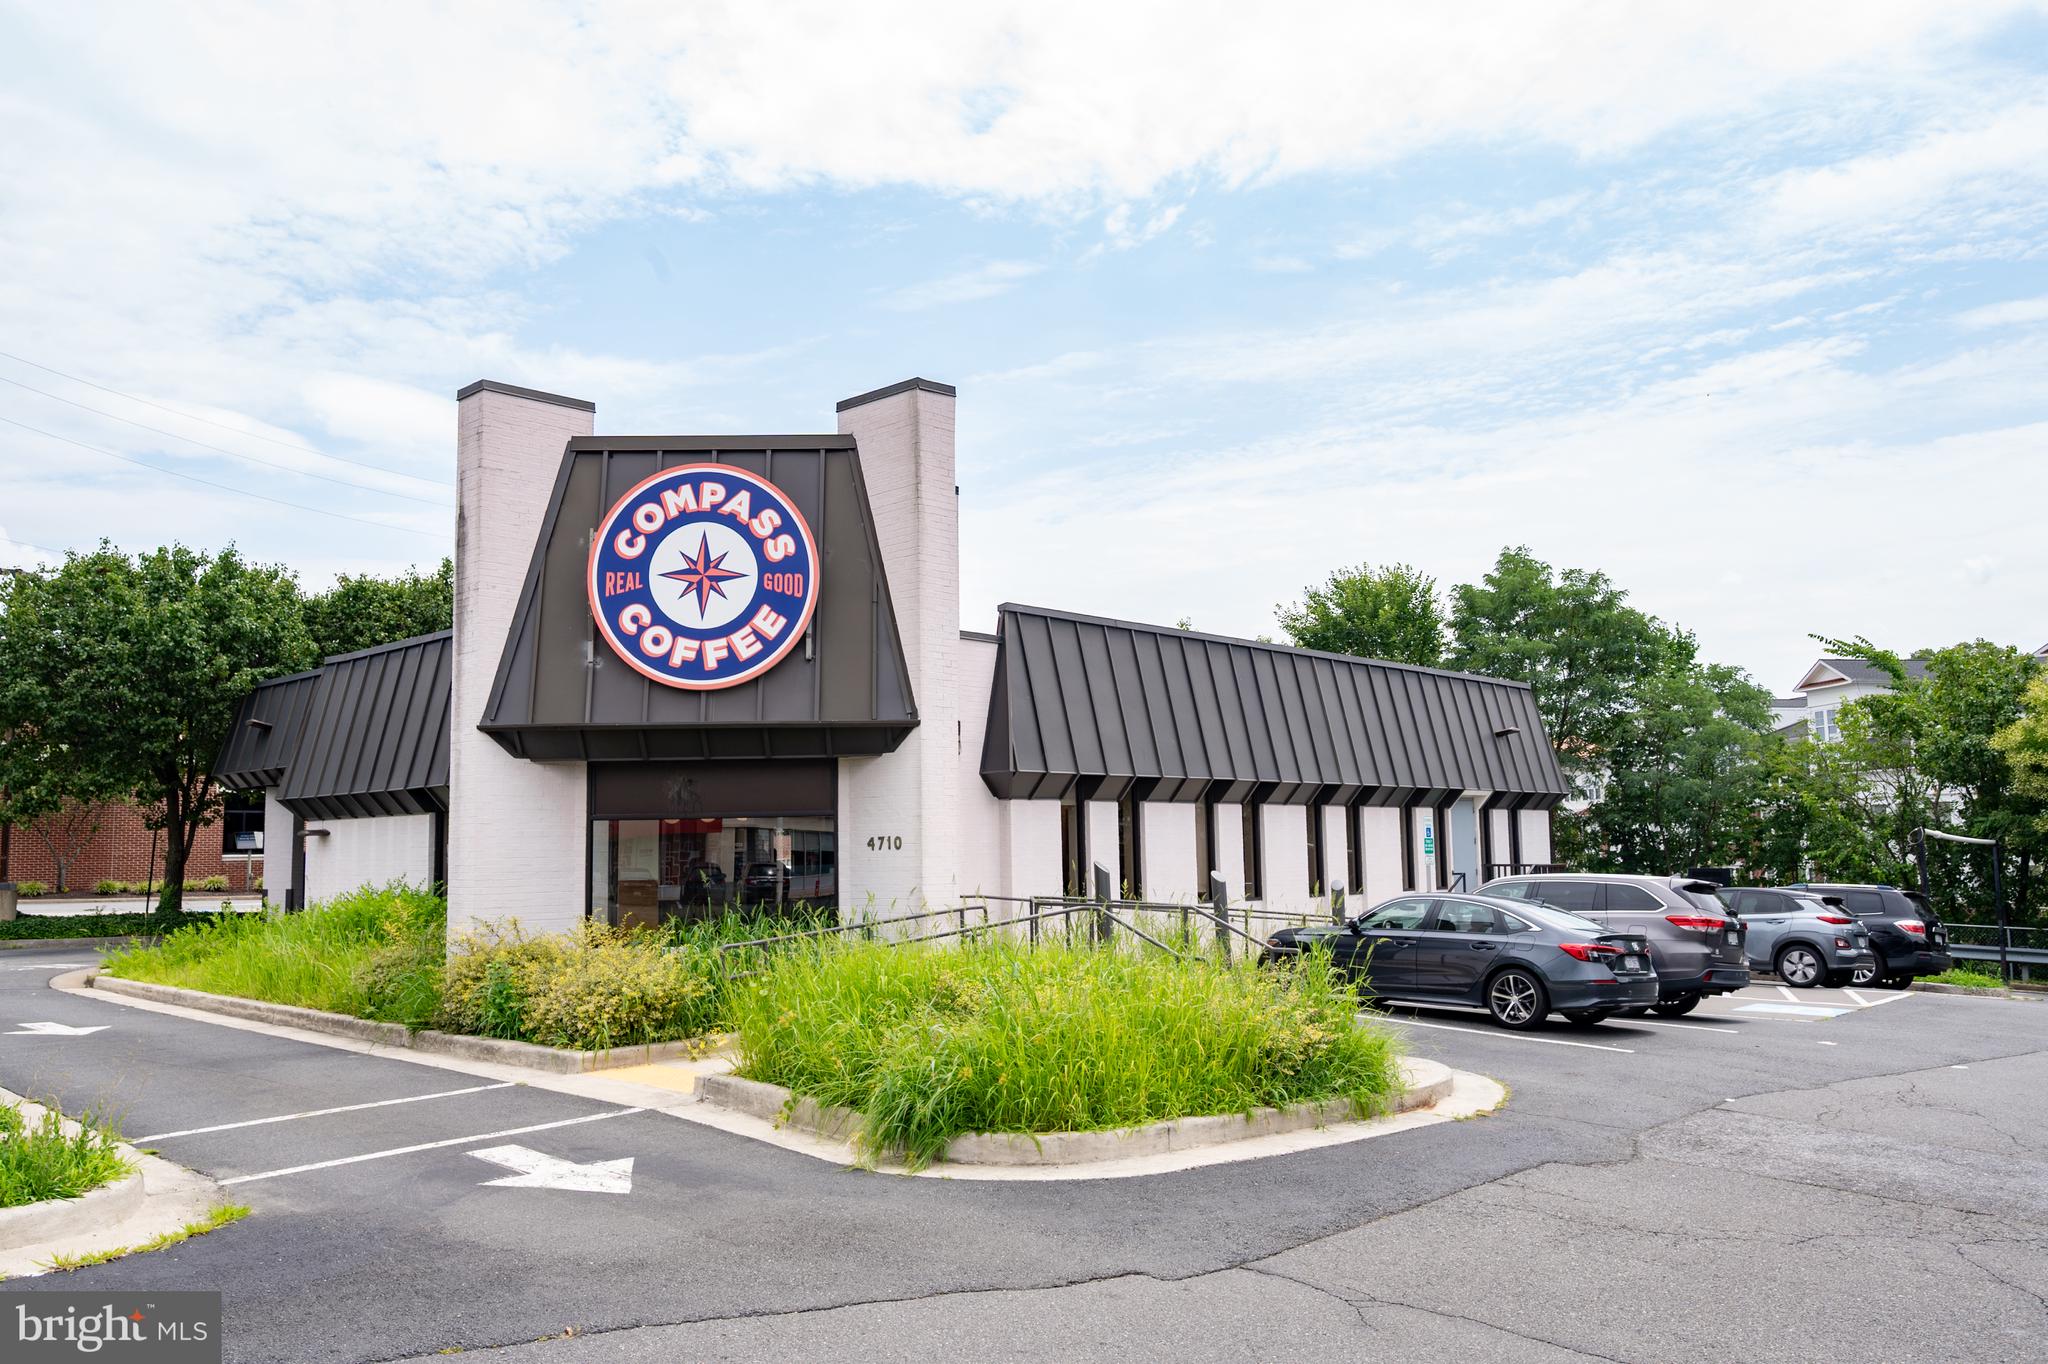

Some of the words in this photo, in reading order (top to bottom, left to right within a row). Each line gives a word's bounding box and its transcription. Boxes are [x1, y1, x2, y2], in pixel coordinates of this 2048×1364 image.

[614, 481, 796, 563] COMPASS
[605, 571, 643, 597] REAL
[763, 573, 804, 598] GOOD
[618, 603, 788, 671] COFFEE
[866, 836, 902, 851] 4710
